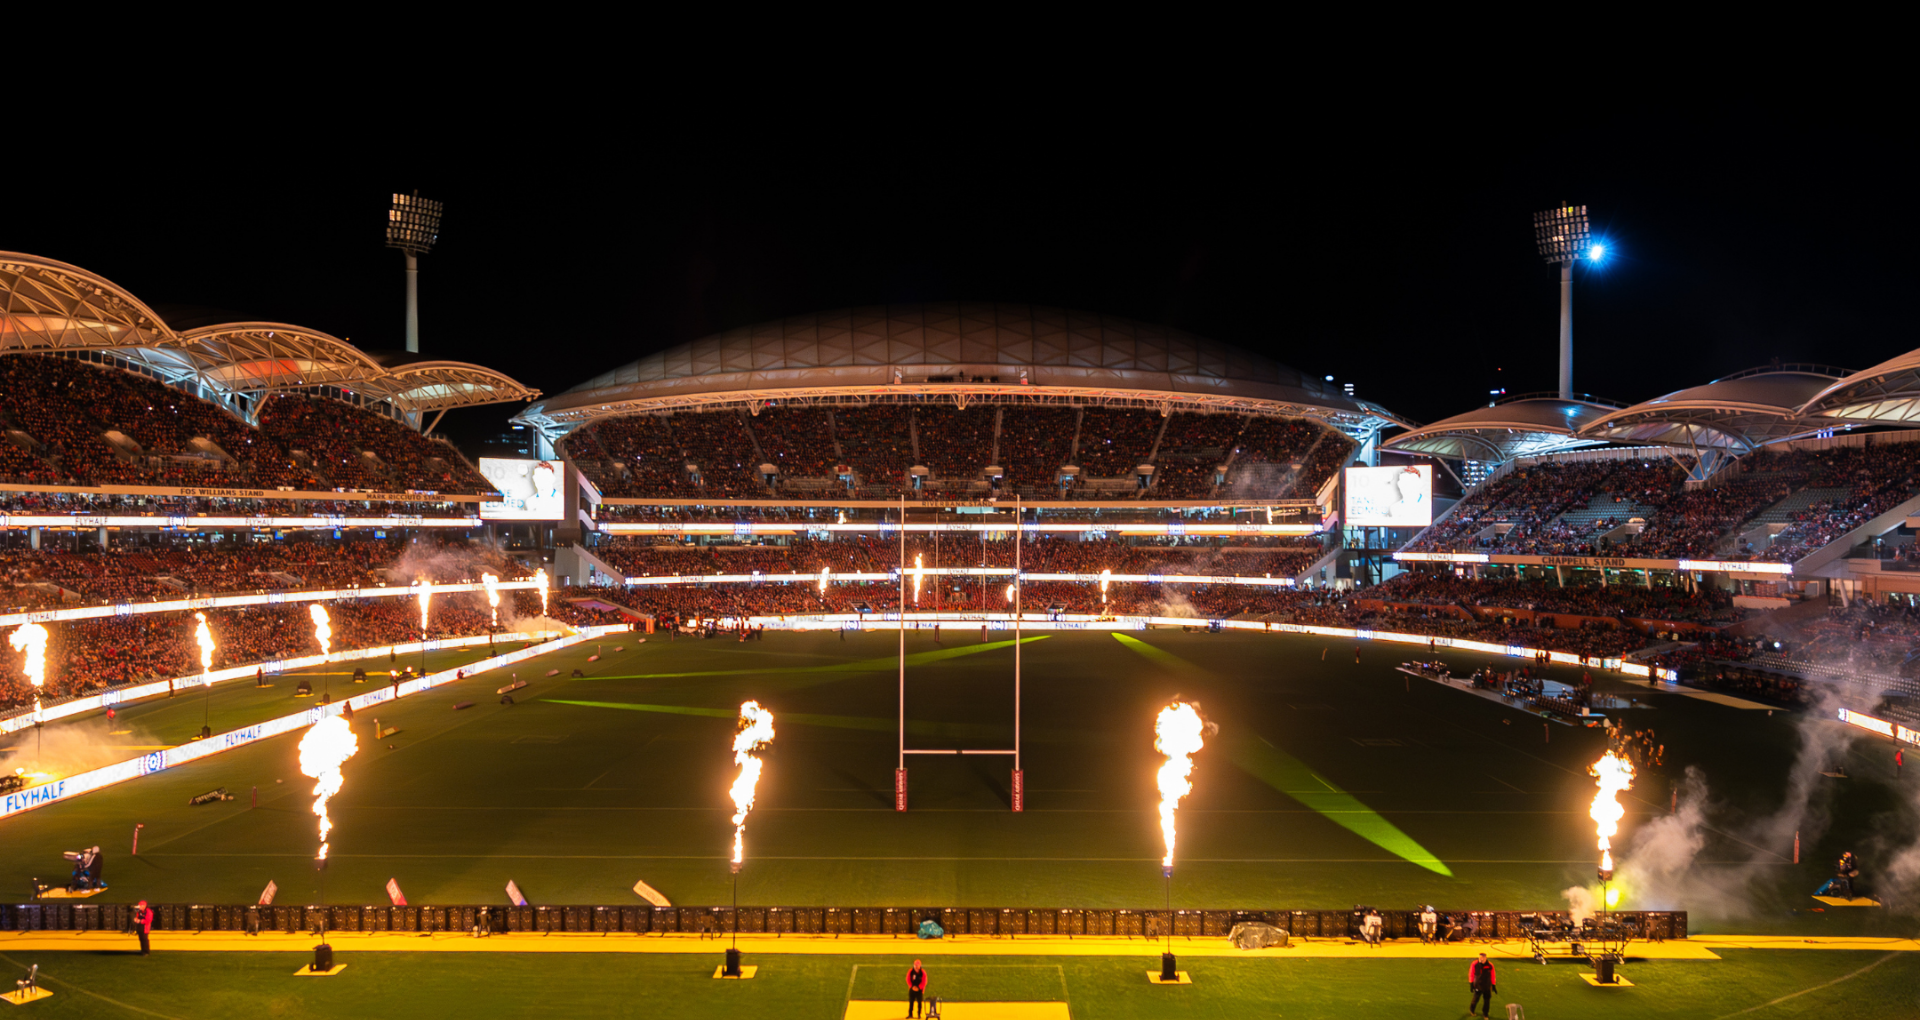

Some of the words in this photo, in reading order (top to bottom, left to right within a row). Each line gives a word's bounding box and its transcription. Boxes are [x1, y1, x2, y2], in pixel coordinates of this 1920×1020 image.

[75, 516, 108, 526] FLYHALF
[1541, 556, 1588, 566] CHAPPELL
[1593, 558, 1625, 567] STAND
[1719, 561, 1750, 572] FLYHALF
[27, 609, 58, 624] FLYHALF
[225, 725, 261, 747] FLYHALF
[6, 781, 65, 813] FLYHALF
